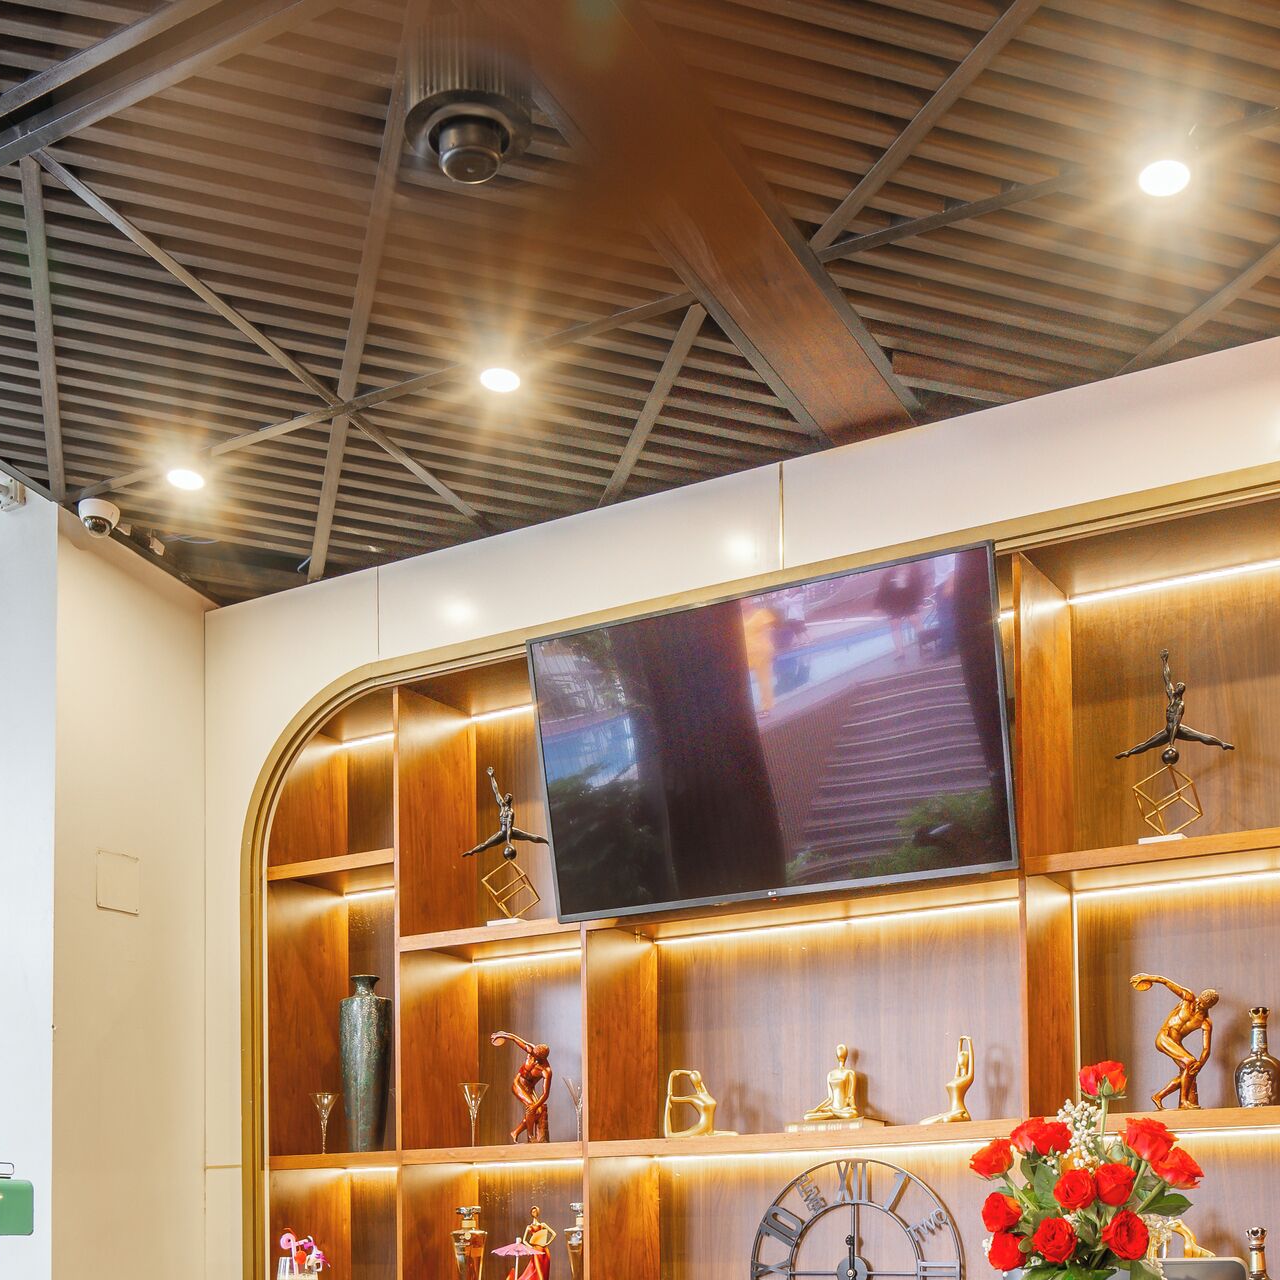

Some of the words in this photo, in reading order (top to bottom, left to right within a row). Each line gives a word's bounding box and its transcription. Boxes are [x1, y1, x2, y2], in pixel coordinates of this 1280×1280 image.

[834, 1159, 869, 1203] XII
[760, 1206, 804, 1248] 10
[906, 1208, 948, 1243] TWO
